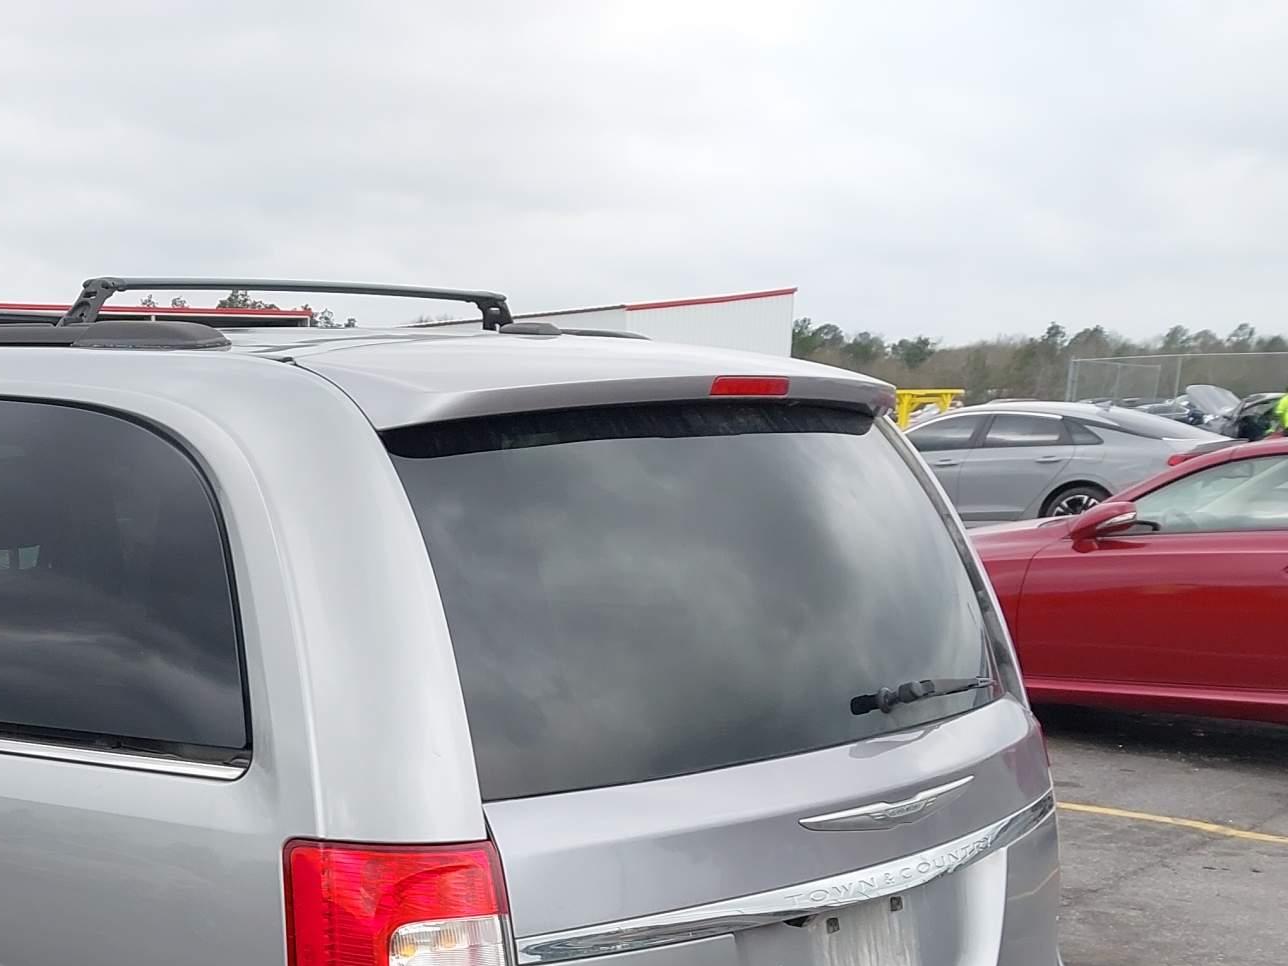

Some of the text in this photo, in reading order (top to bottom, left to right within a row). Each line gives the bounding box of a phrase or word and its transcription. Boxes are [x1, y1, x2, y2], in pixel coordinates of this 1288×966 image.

[783, 834, 993, 907] TOWN & COUNTRY
